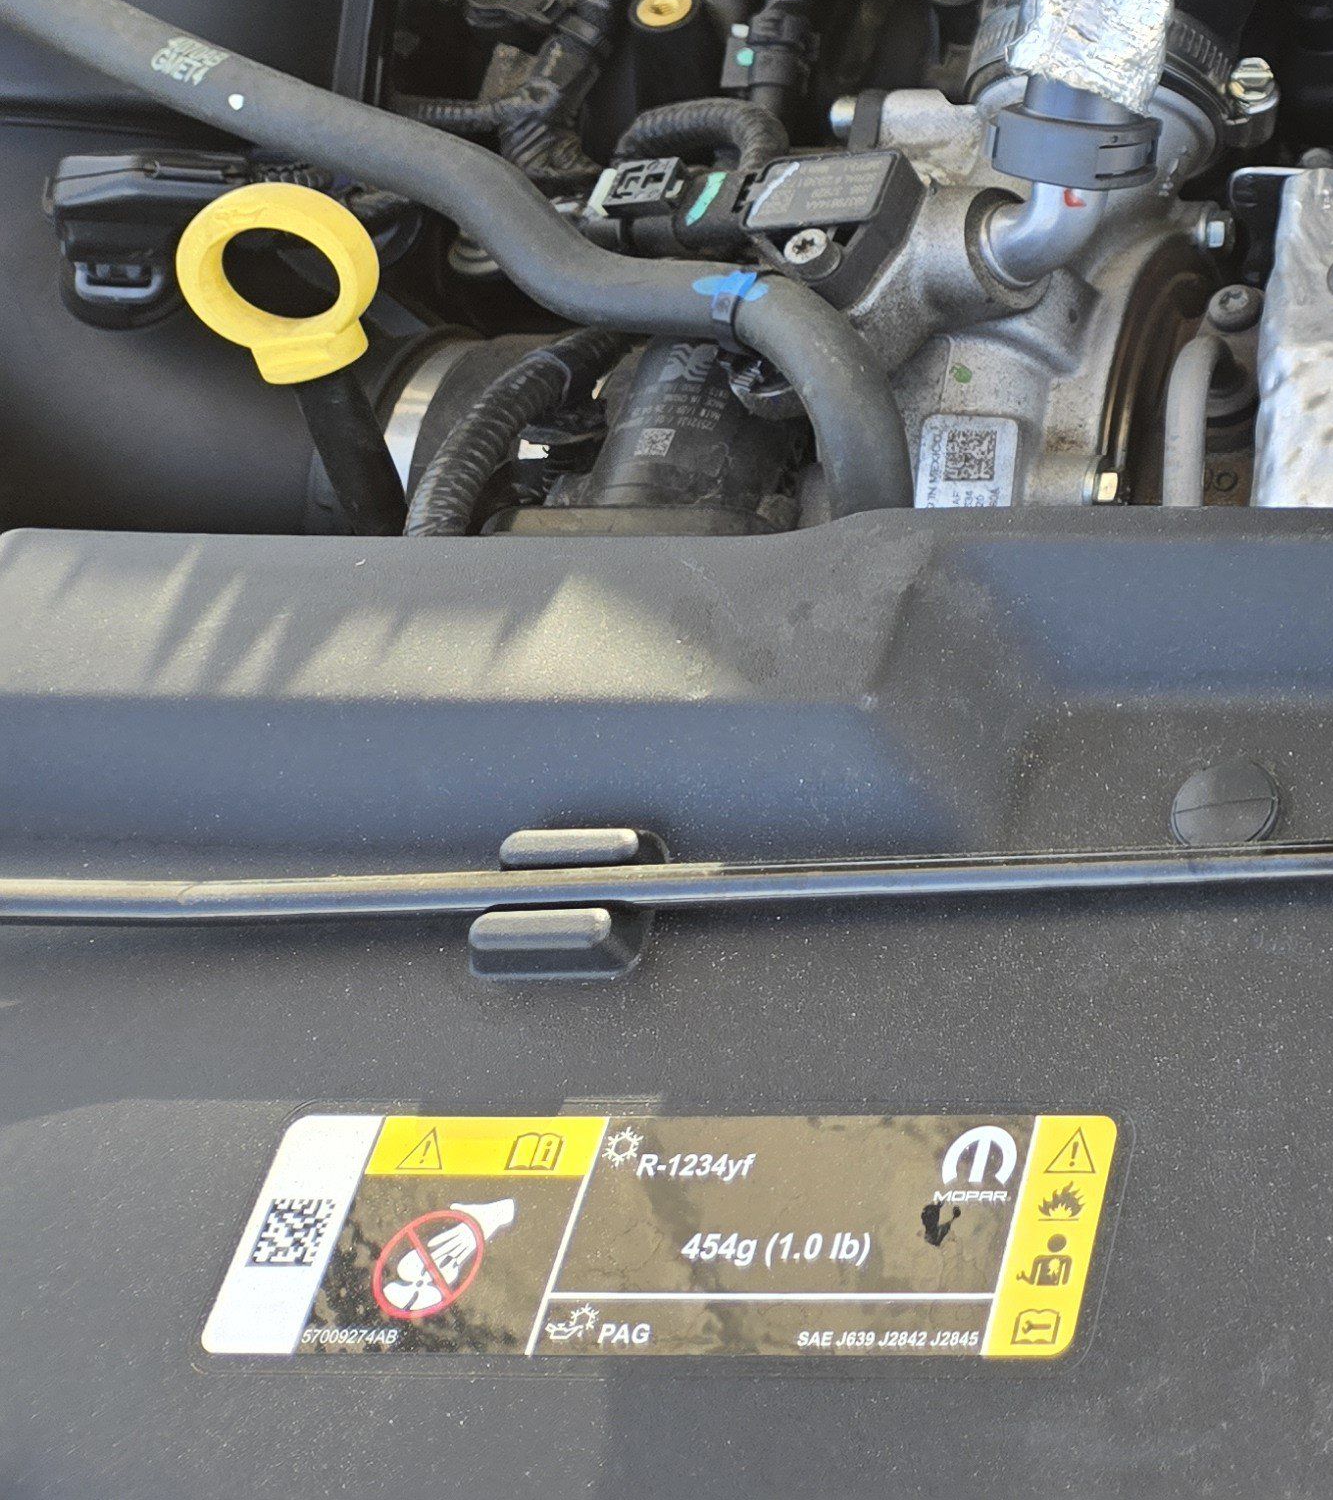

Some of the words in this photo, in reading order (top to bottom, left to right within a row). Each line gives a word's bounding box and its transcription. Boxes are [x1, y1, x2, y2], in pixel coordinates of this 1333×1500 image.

[636, 1153, 757, 1182] R-1234yf
[933, 1190, 1008, 1203] MOPAR
[681, 1233, 758, 1266] 454g
[765, 1233, 823, 1268] (1.0
[830, 1232, 872, 1268] lb)
[597, 1323, 651, 1344] PAG
[797, 1331, 832, 1347] SAE
[836, 1331, 875, 1347] J639
[878, 1331, 926, 1348] J2842
[930, 1331, 979, 1347] J2845
